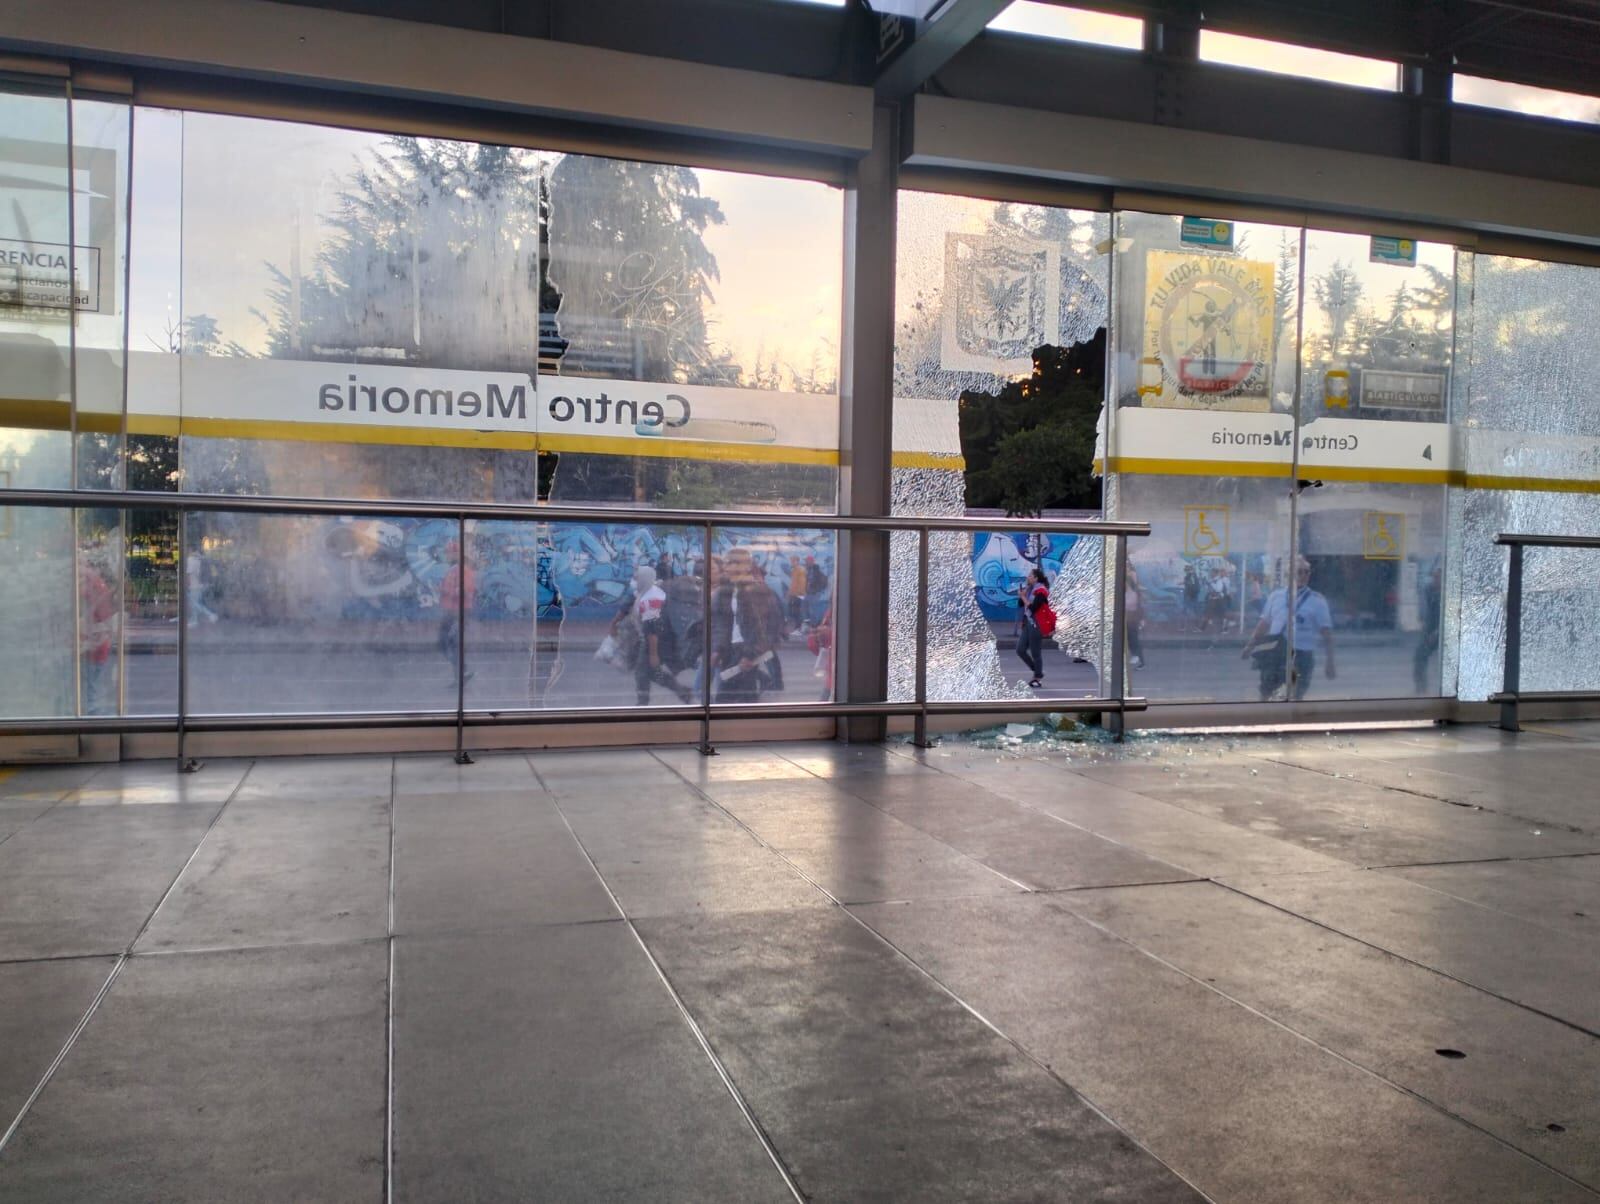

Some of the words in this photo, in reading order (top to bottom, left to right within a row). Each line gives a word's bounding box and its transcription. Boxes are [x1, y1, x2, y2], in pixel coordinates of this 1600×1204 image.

[1150, 286, 1169, 309] TU
[1165, 261, 1203, 289] VIDA
[1207, 259, 1246, 284] VALE
